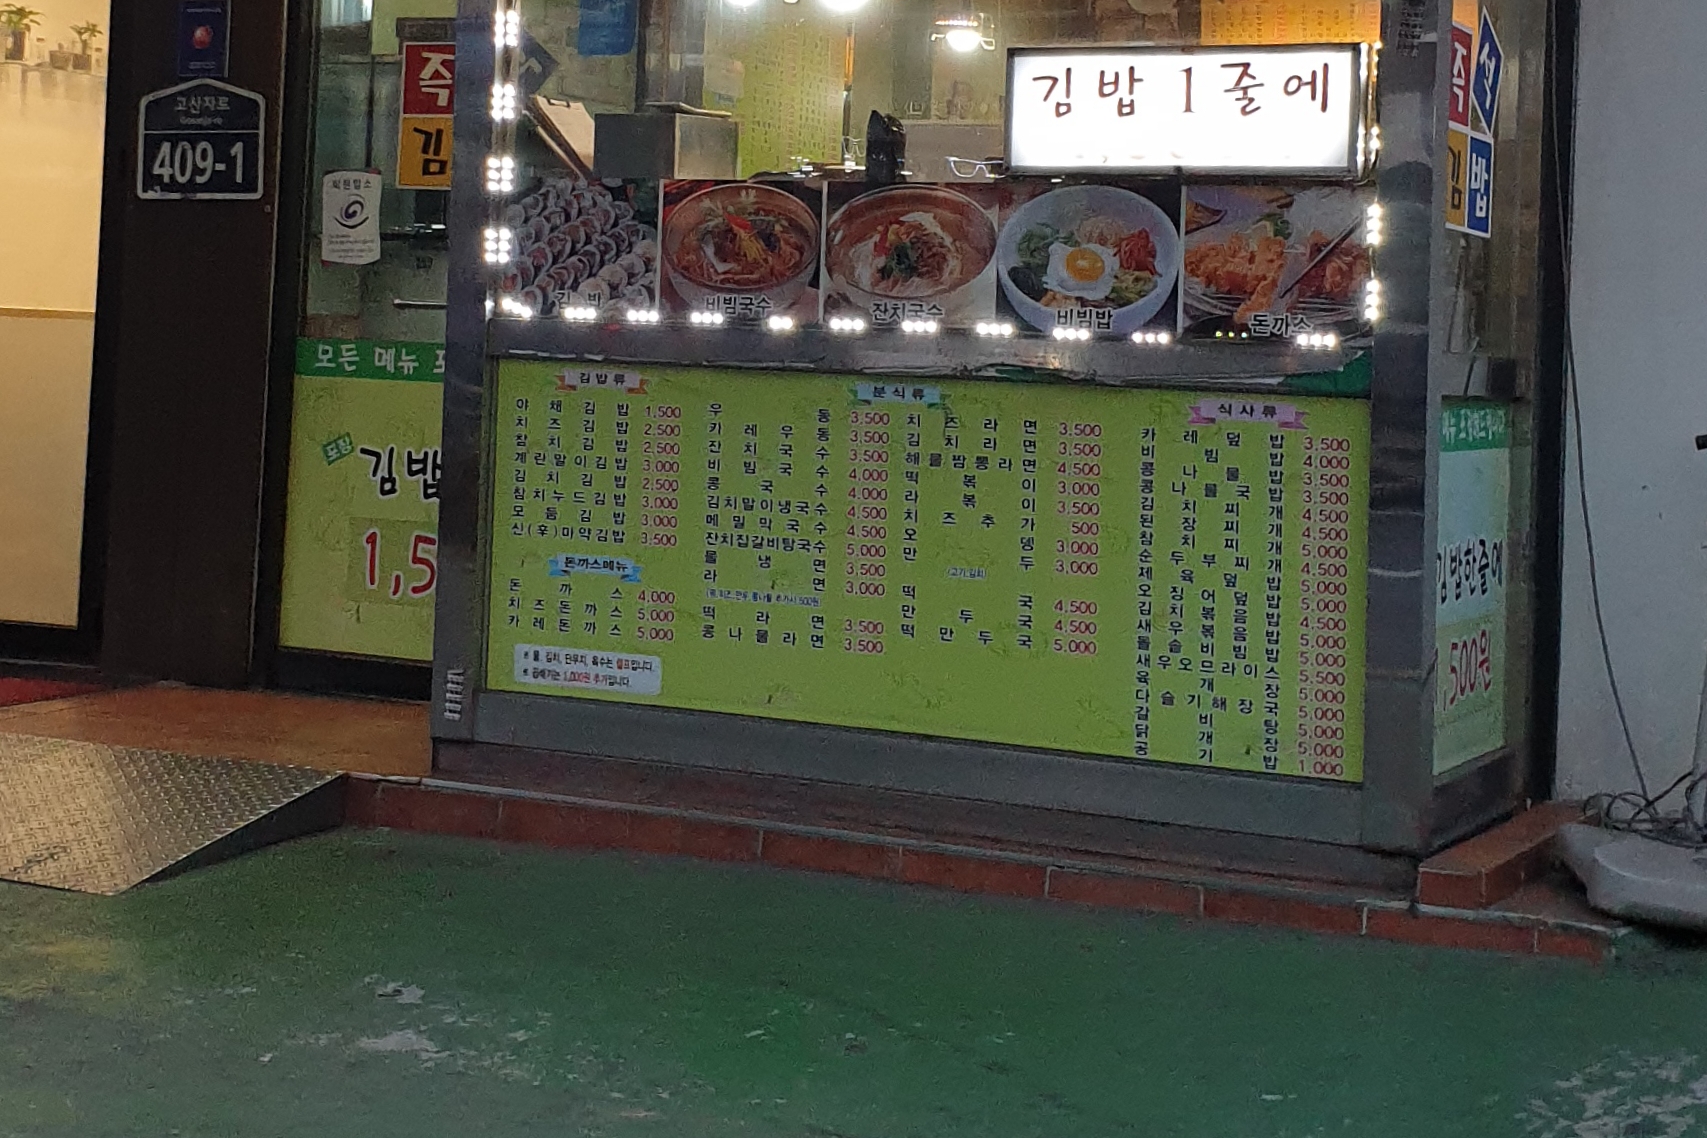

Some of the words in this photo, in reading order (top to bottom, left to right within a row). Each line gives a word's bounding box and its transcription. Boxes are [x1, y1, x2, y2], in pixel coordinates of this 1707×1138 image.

[152, 141, 244, 185] 409-1
[705, 295, 772, 316] 비빔국수
[1056, 308, 1113, 329] 비빔밥
[1250, 314, 1313, 336] 돈까스
[314, 343, 361, 372] 모든
[373, 347, 420, 375] 메뉴
[1072, 522, 1099, 535] 500
